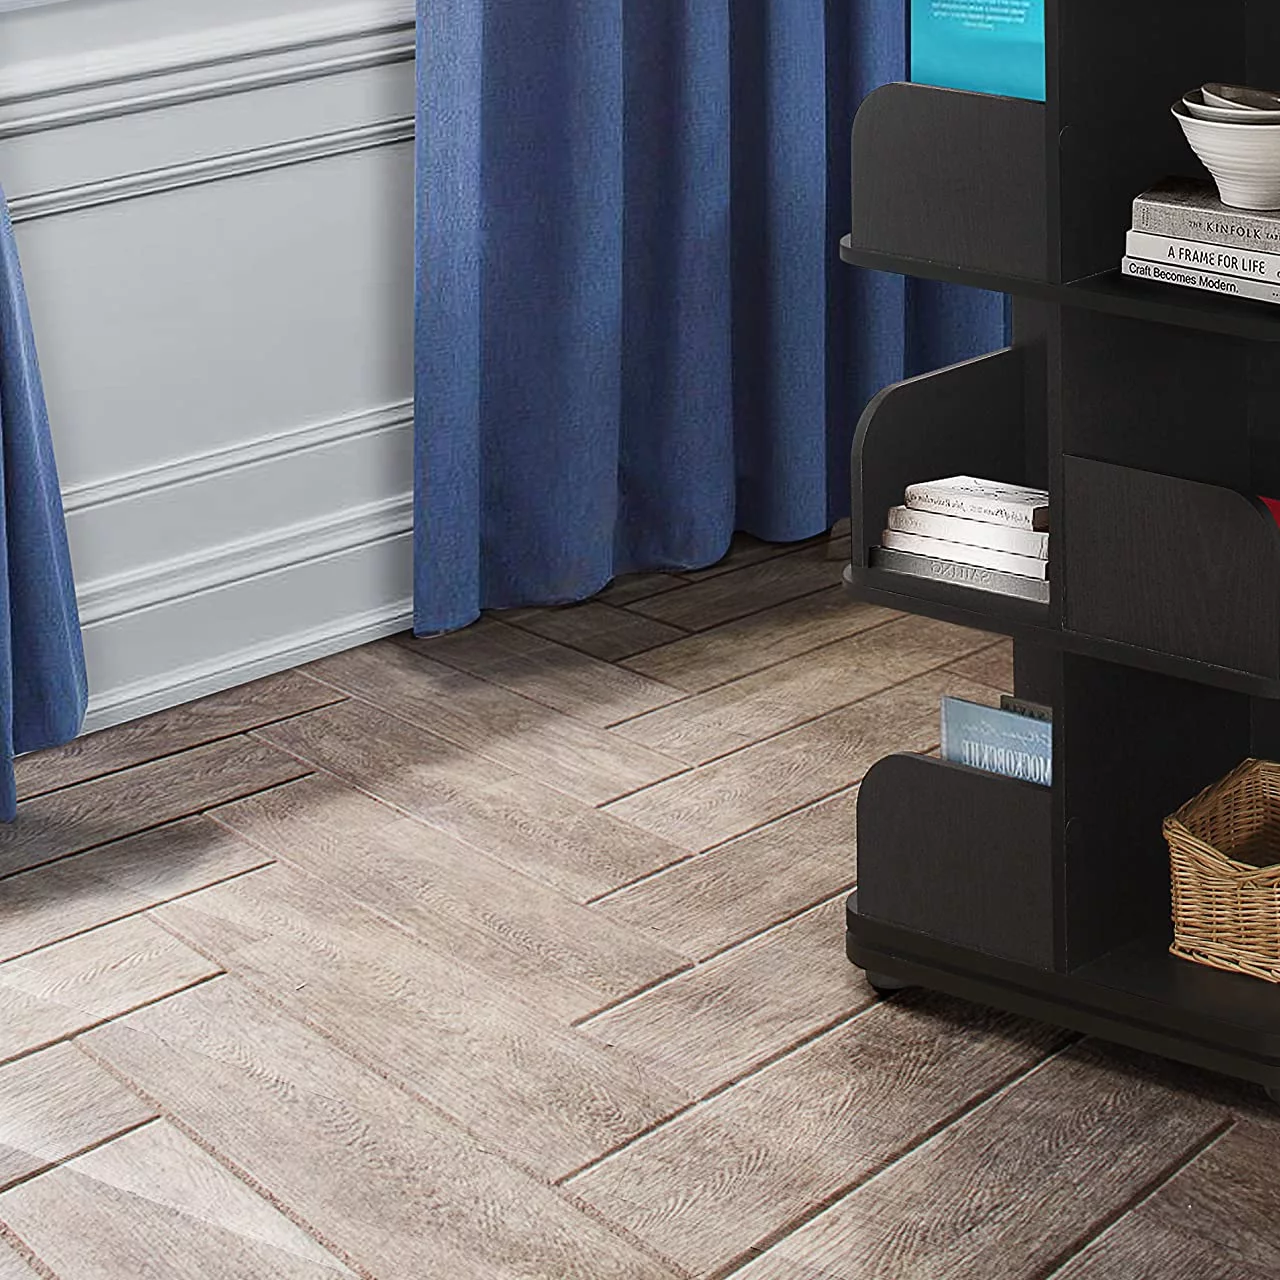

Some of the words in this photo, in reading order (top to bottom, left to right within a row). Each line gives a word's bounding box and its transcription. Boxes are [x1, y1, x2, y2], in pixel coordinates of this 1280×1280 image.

[1189, 220, 1203, 229] THE
[1206, 221, 1262, 240] KINFOLK
[1167, 245, 1175, 259] A
[1179, 248, 1215, 266] FRAME
[1217, 256, 1238, 270] FOR
[1242, 259, 1266, 275] LIFE
[1129, 262, 1152, 276] Craft
[1154, 269, 1197, 285] Becomes
[1199, 275, 1239, 293] Modern.
